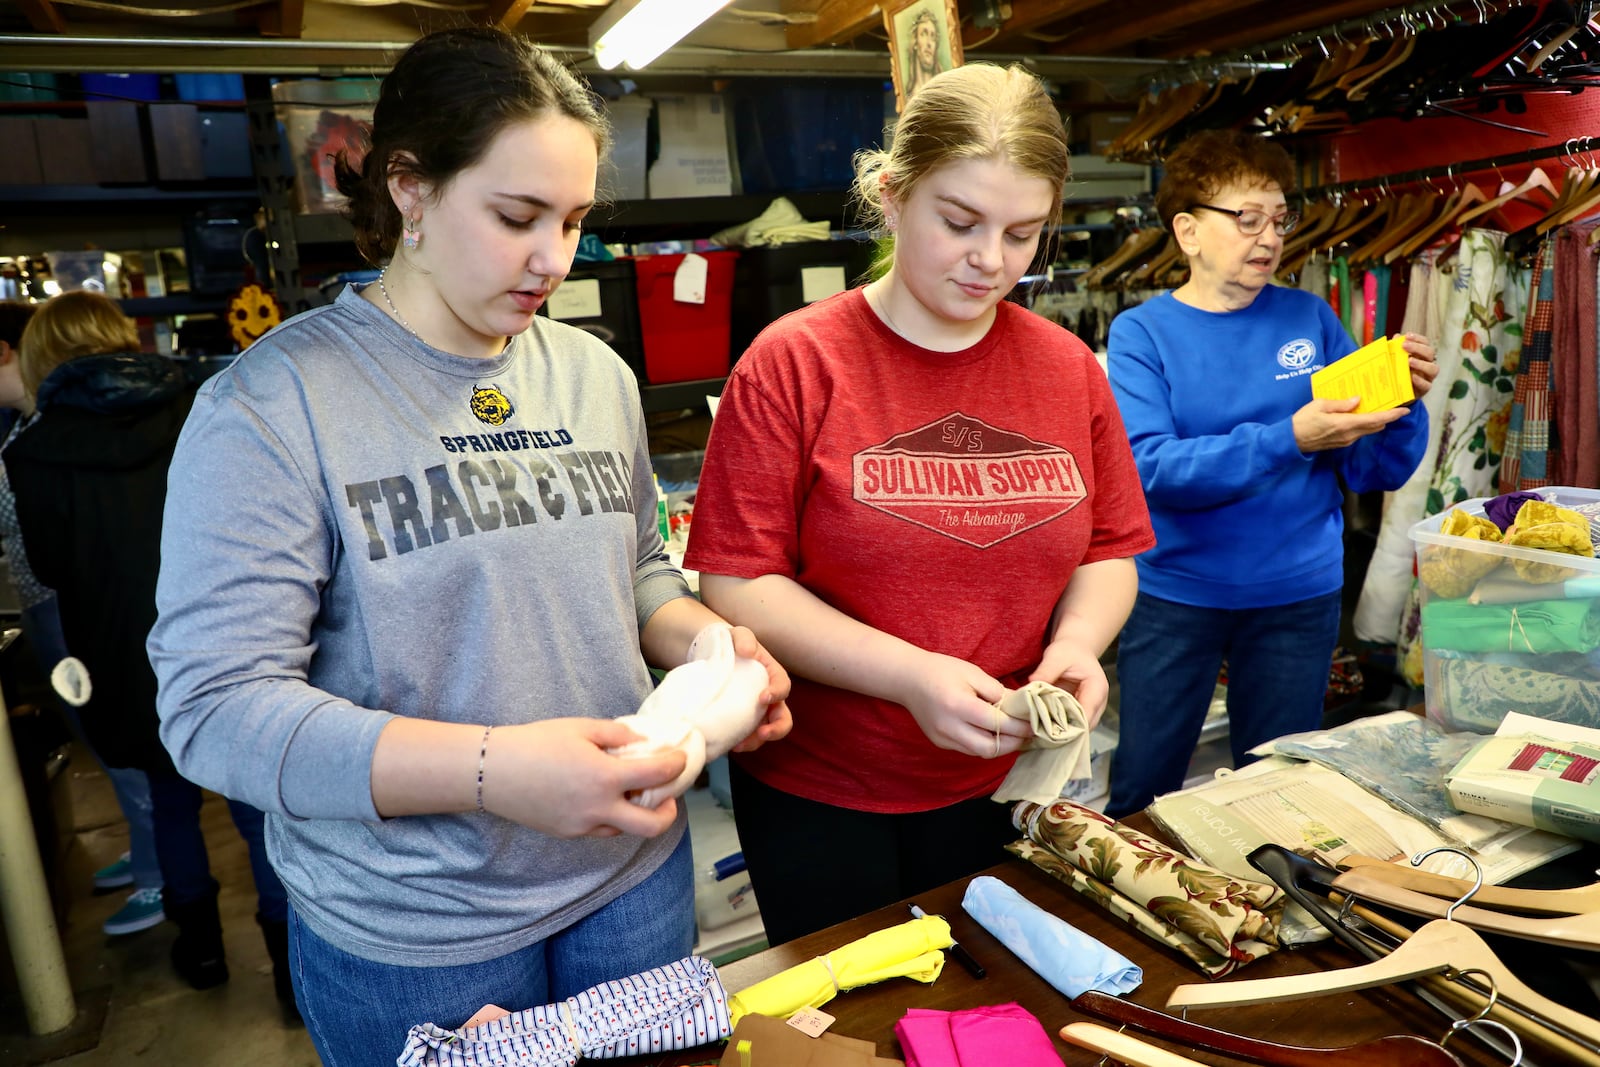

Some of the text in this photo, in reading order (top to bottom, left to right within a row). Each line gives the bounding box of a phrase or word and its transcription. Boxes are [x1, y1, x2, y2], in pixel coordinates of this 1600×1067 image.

[440, 428, 574, 453] SPRINGFIELD
[942, 422, 983, 451] S/S
[862, 457, 1078, 497] SULLIVAN SUPPLY
[345, 459, 537, 561] TRACK
[529, 459, 566, 520] &
[939, 509, 1026, 532] The Advantage
[1190, 803, 1239, 838] panel
